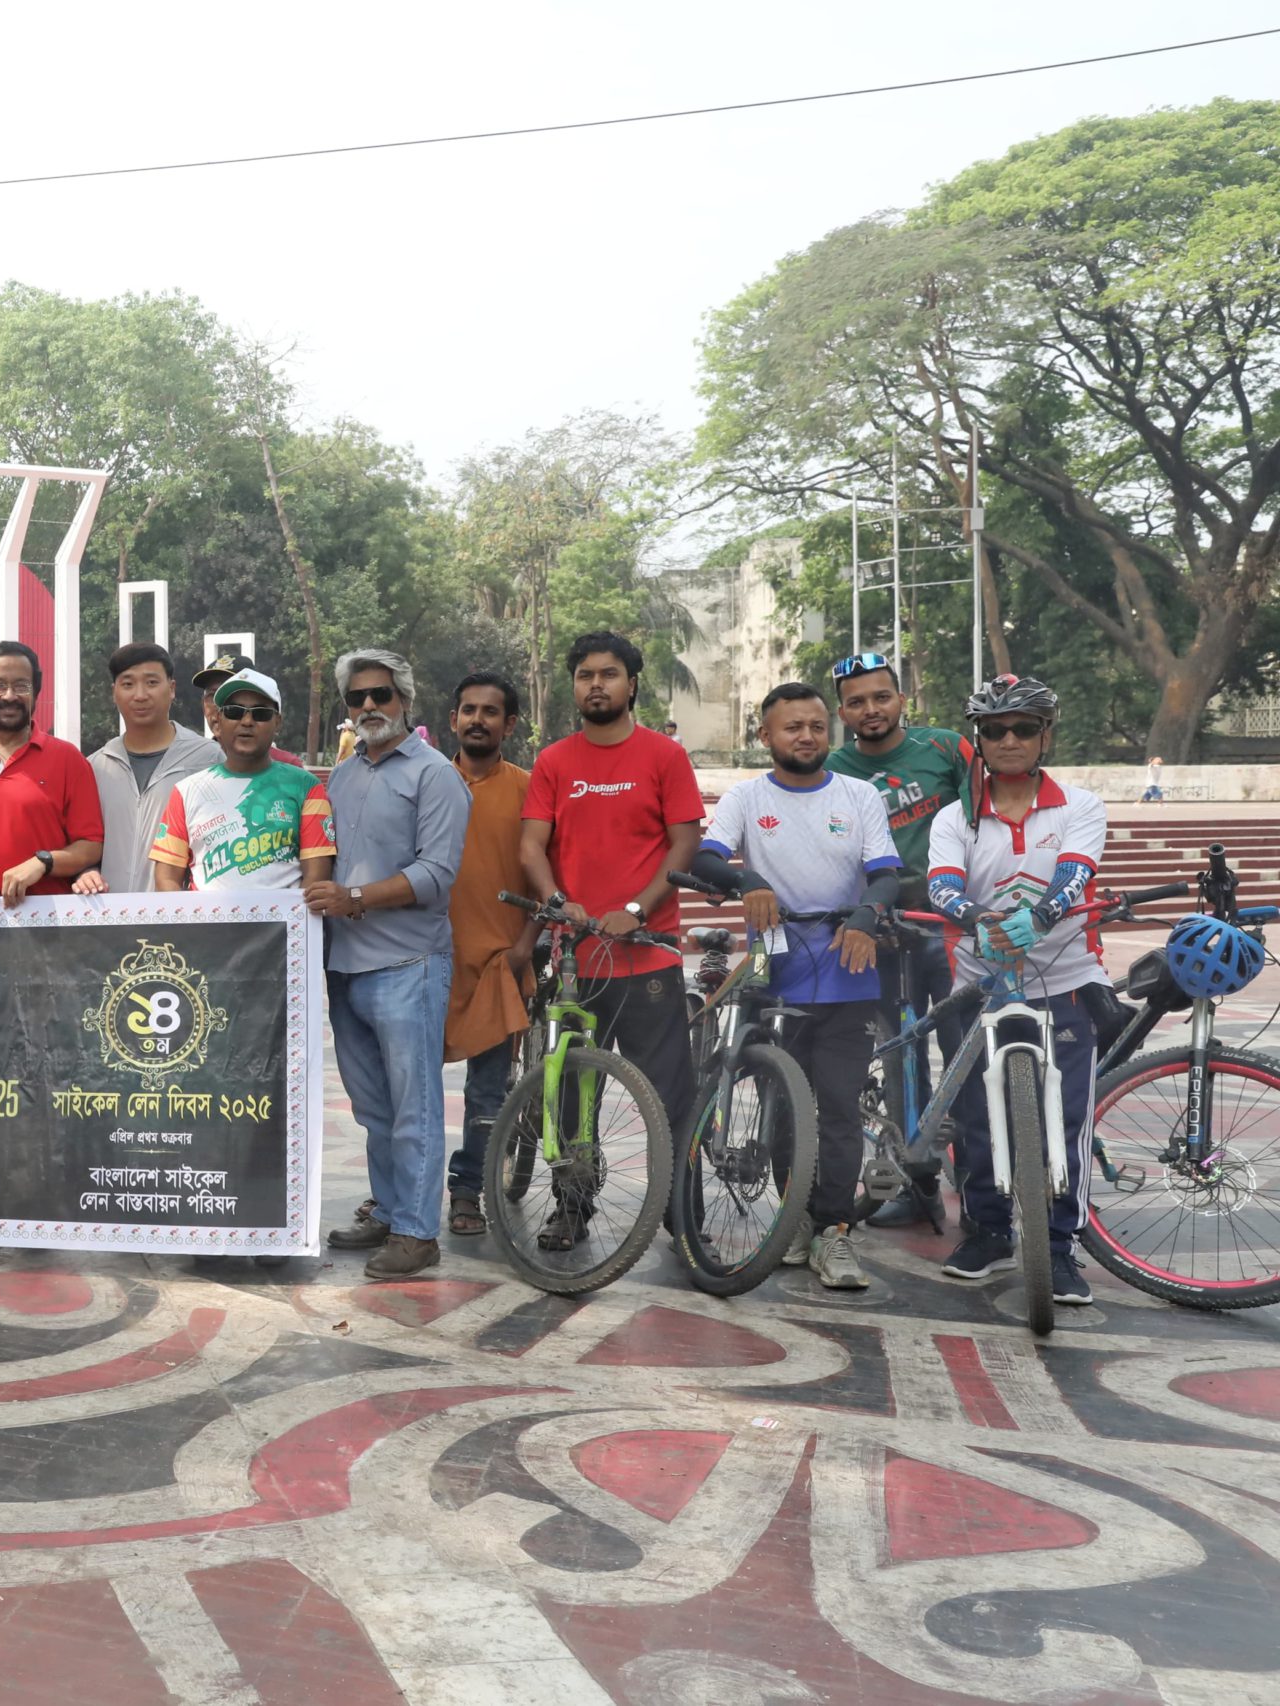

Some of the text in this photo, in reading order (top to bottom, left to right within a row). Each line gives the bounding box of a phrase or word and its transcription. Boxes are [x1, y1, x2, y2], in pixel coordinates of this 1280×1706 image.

[890, 794, 942, 830] ROJECT
[204, 828, 294, 878] LAL SOBUJ
[127, 990, 181, 1035] ১৪
[138, 1036, 171, 1056] তম
[52, 1083, 273, 1123] সাইকেল লেন দিবস ২০২৫
[1188, 1066, 1202, 1137] EPICON
[109, 1128, 135, 1145] এপ্রিল
[137, 1131, 160, 1146] প্রথম
[88, 1163, 228, 1190] বাংলাদেশ সাইকেল
[79, 1191, 109, 1212] লেন
[186, 1189, 239, 1216] পরিষদ
[1113, 1254, 1205, 1292] SCHWALBE
